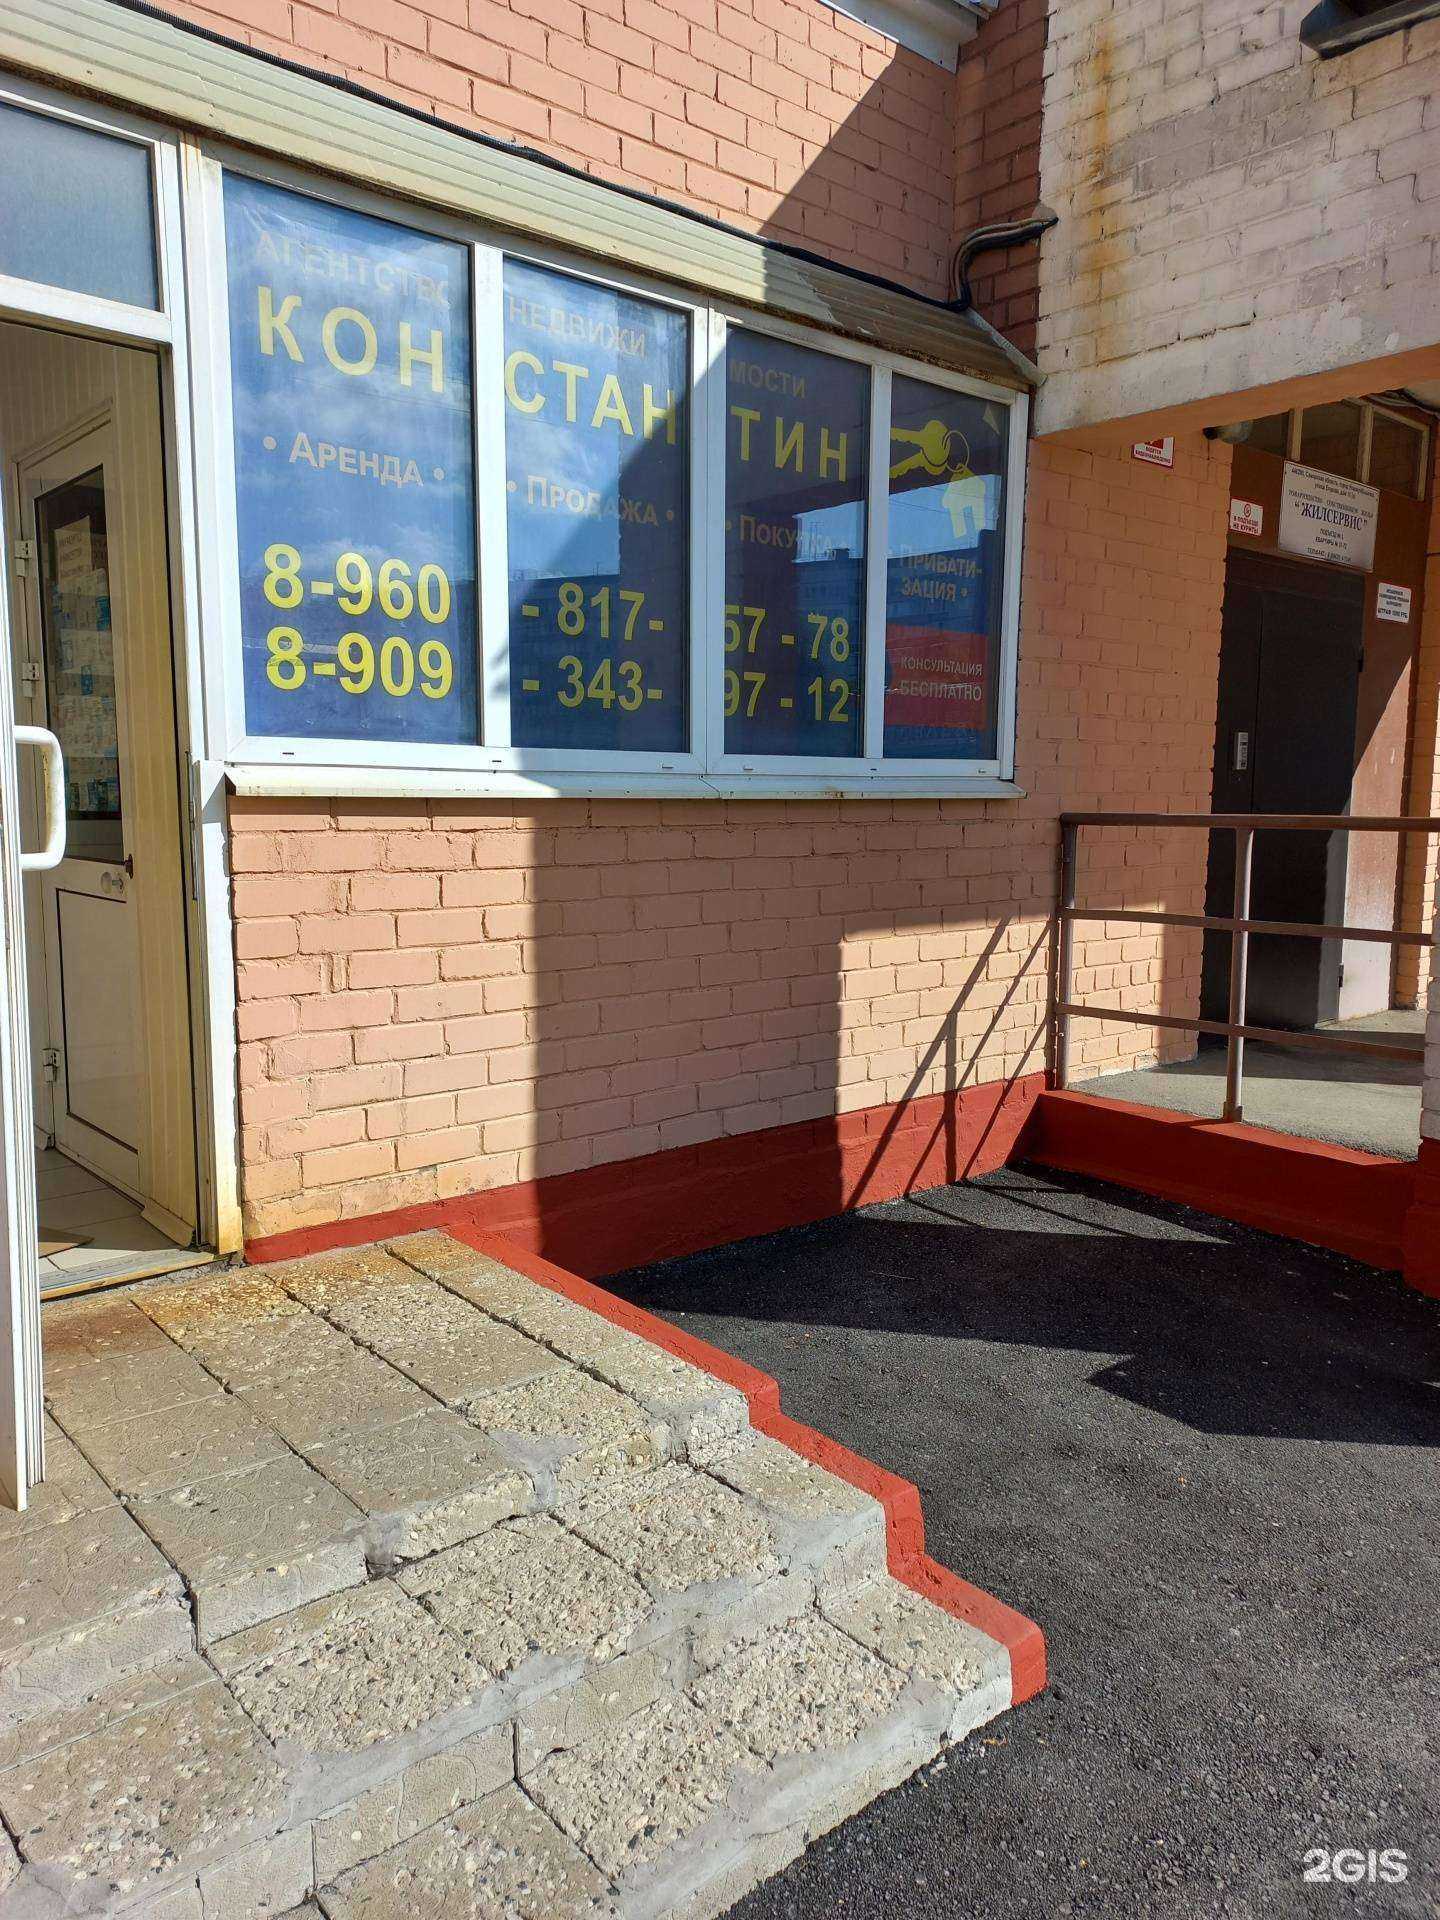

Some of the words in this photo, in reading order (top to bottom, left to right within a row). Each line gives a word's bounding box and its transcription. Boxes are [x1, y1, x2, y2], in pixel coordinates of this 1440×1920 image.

[257, 285, 444, 393] КОН
[504, 350, 677, 445] СТАН
[730, 405, 848, 483] ТИН
[509, 297, 646, 360] НЕДВИЖИ
[729, 359, 806, 399] МОСТИ
[263, 543, 451, 625] 8-960
[807, 612, 850, 662] 78
[902, 577, 956, 603] ЗАЦИЯ
[266, 626, 453, 699] 8-909
[723, 669, 766, 717] 97
[807, 676, 849, 722] 12
[900, 680, 982, 702] БЕСПЛАТНО
[901, 656, 983, 676] КОНСУЛЬТАЦИЯ
